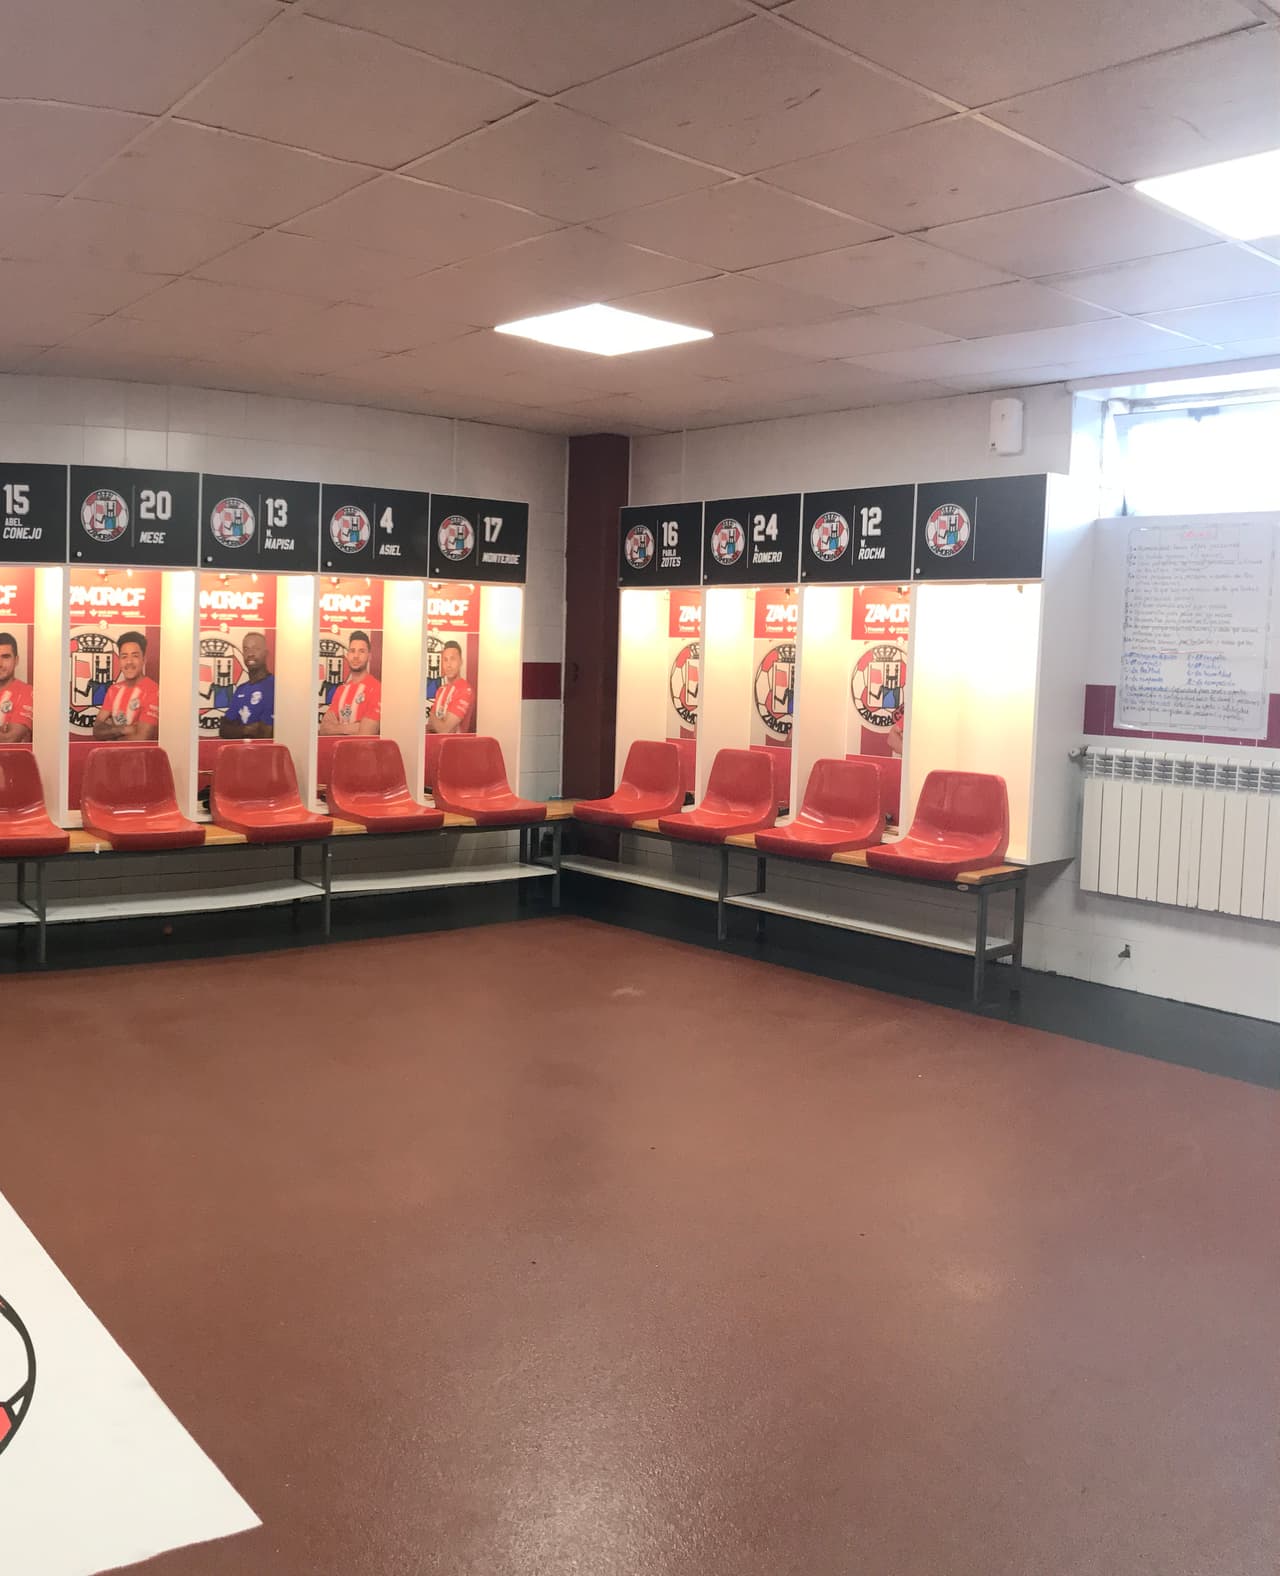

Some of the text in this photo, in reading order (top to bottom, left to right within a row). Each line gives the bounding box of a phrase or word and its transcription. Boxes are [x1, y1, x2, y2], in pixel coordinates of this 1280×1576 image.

[3, 484, 29, 515] 15
[140, 490, 171, 520] 20
[265, 498, 287, 527] 13
[3, 527, 42, 539] CONEJO
[5, 517, 23, 526] ABEL
[380, 507, 394, 534] 4
[484, 517, 503, 542] 17
[753, 514, 778, 542] 24
[860, 507, 882, 536] 12
[662, 521, 678, 547] 16
[661, 557, 681, 567] ZOTES
[753, 552, 782, 563] ROMERO
[858, 546, 885, 560] ROCHA
